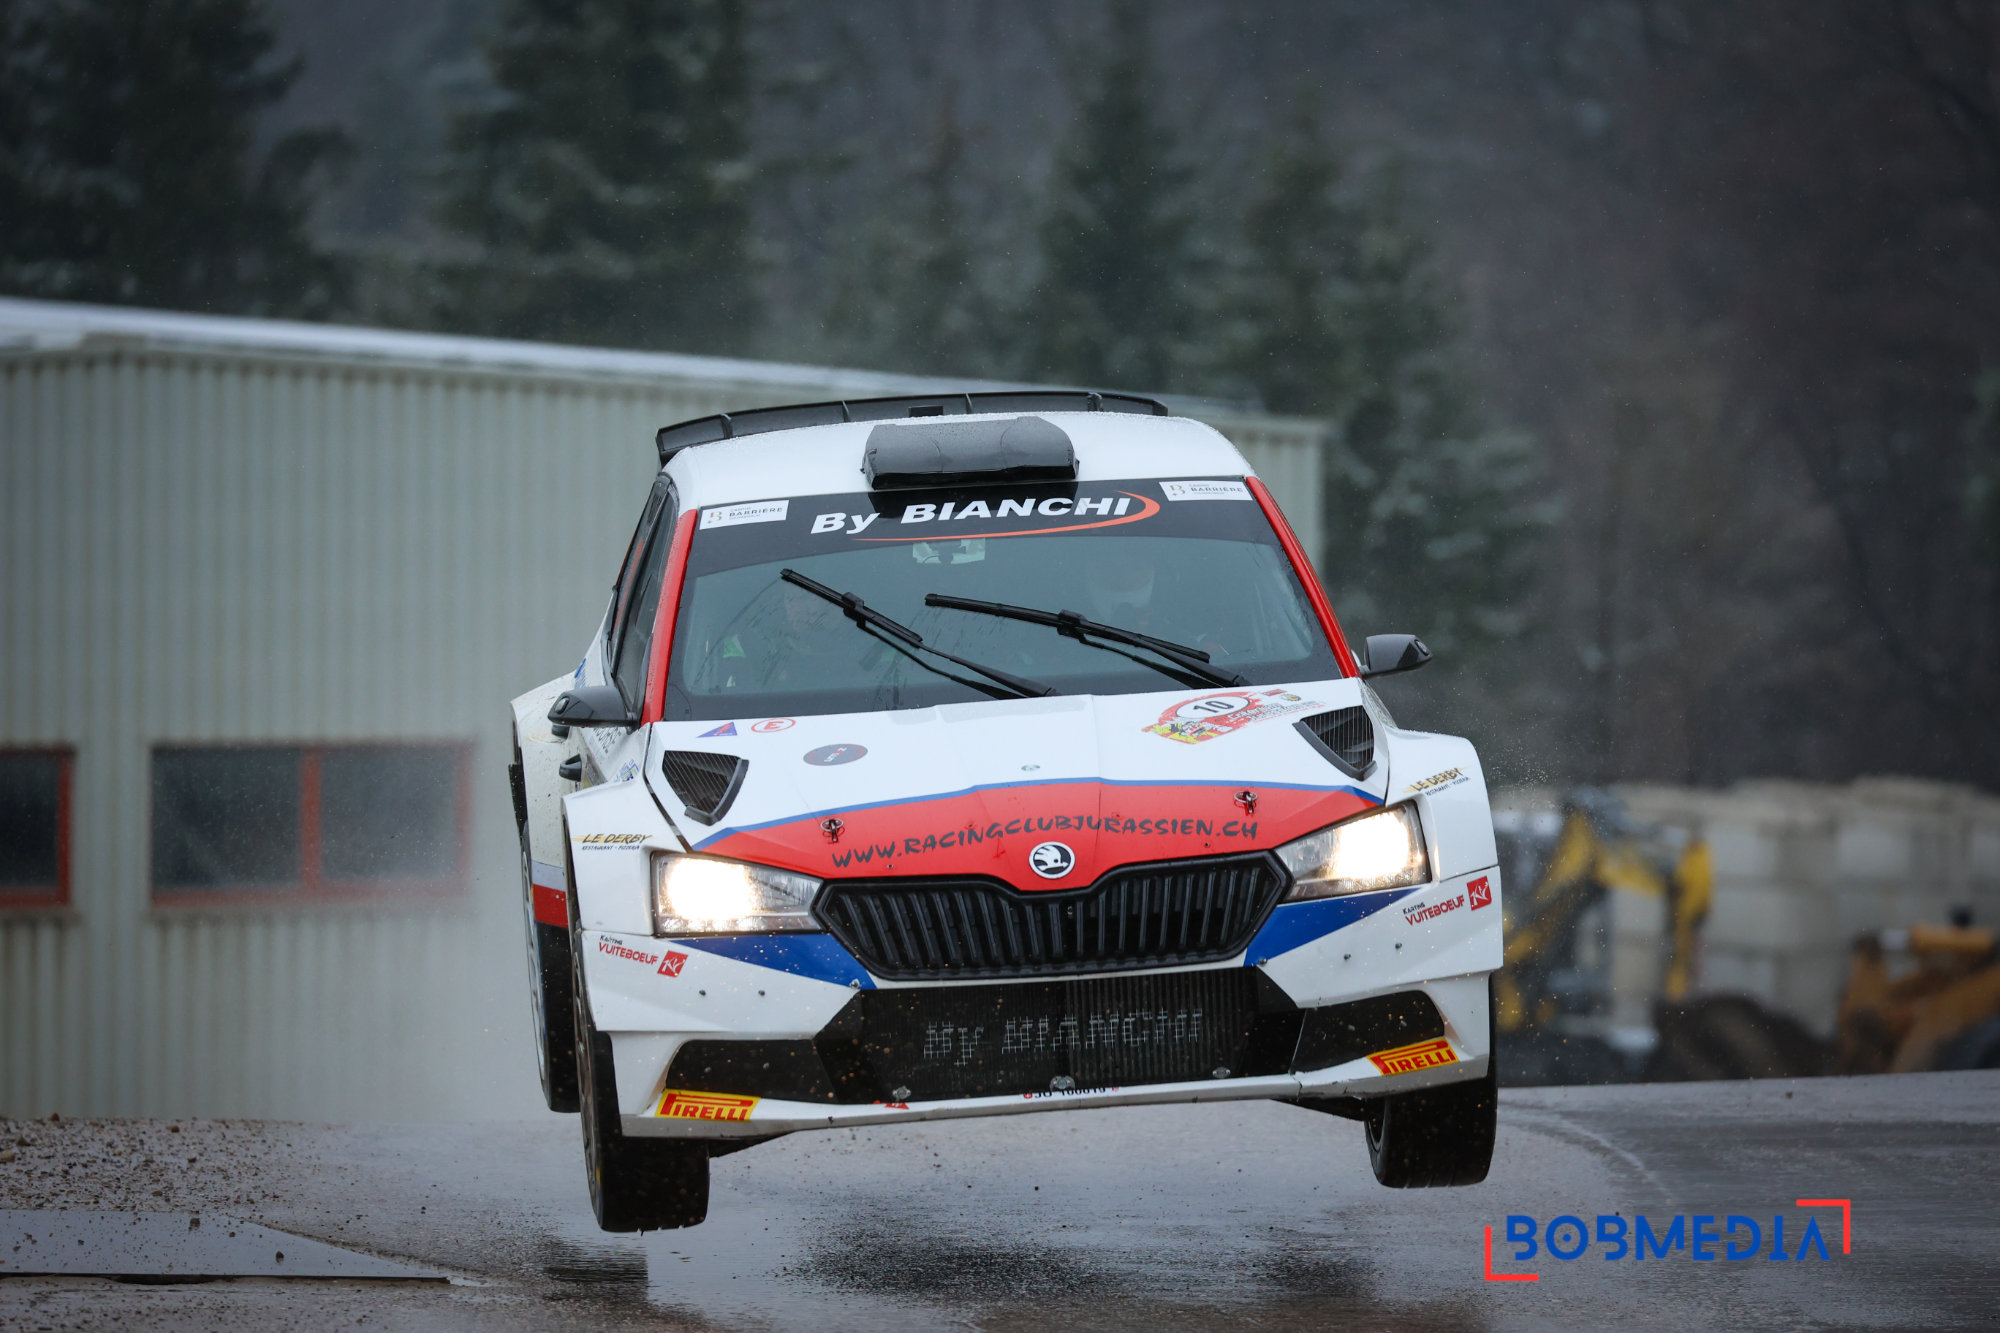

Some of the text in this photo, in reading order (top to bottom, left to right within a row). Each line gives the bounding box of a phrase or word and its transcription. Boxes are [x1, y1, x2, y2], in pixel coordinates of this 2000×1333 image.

[810, 497, 1131, 535] By BIANCHI
[1193, 700, 1235, 713] 10
[1410, 767, 1464, 791] LE DERBY
[582, 833, 650, 844] LE DERBY
[1405, 894, 1465, 925] VUITEBOEUF
[598, 942, 659, 965] VUITEBOEUF
[1369, 1040, 1457, 1076] PIRELLI
[660, 1093, 754, 1121] PIRELLI
